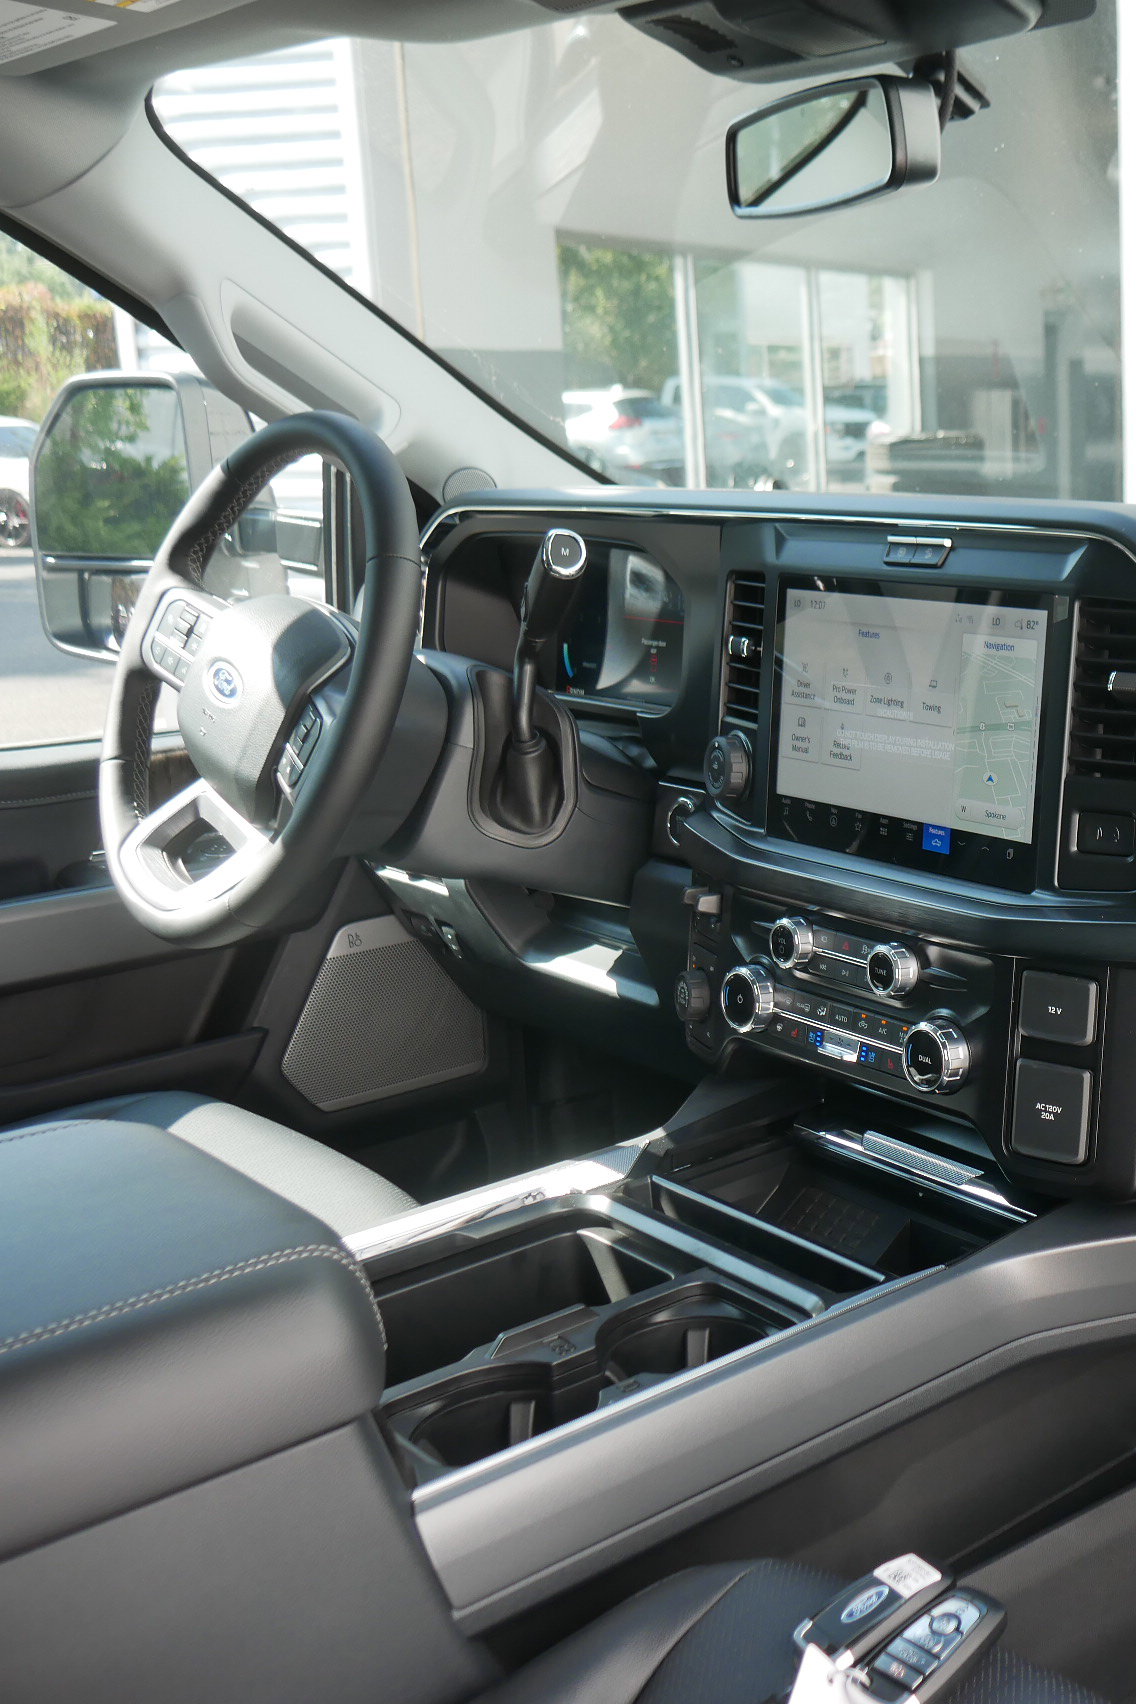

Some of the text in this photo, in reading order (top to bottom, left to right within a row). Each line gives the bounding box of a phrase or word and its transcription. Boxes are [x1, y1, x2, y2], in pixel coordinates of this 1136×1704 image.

[561, 547, 570, 557] M
[991, 617, 1001, 626] LO
[858, 629, 881, 640] Features
[983, 641, 1015, 652] Navigation
[797, 680, 811, 689] Driver
[832, 684, 857, 696] Pro Power
[791, 689, 816, 701] Assistance
[833, 695, 855, 706] Onboard
[869, 694, 905, 709] Zone Lighting
[922, 702, 942, 714] Towing
[791, 733, 811, 743] Owner's
[791, 743, 810, 754] Manual
[829, 750, 853, 762] Feedback
[960, 804, 968, 813] W
[984, 809, 1007, 821] Spokane
[928, 826, 946, 837] Features
[875, 966, 887, 977] TUNE
[1047, 1006, 1063, 1015] 12 V
[835, 1014, 848, 1023] AUTO
[878, 1027, 888, 1036] A/C
[918, 1054, 932, 1065] DUAL
[1035, 1102, 1063, 1114] AC 120V
[1041, 1111, 1055, 1121] 20A
